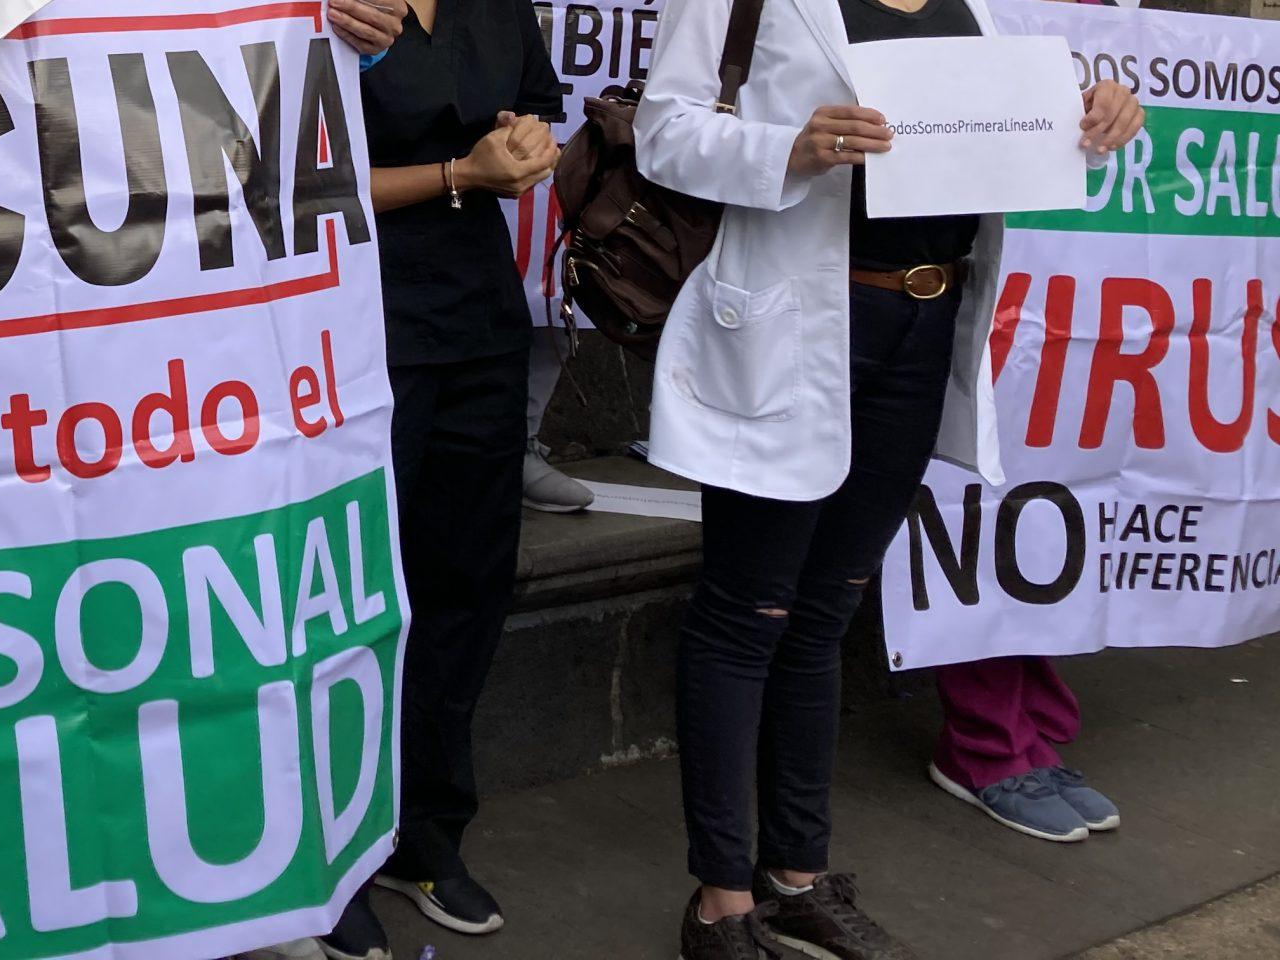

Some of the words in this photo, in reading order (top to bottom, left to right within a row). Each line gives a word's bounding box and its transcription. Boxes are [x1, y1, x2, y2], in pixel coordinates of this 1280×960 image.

[1071, 51, 1140, 95] DOS
[1174, 127, 1280, 218] SAL
[1, 358, 261, 483] todo
[289, 329, 344, 438] el
[907, 480, 1087, 611] NO
[1098, 501, 1204, 543] HACE
